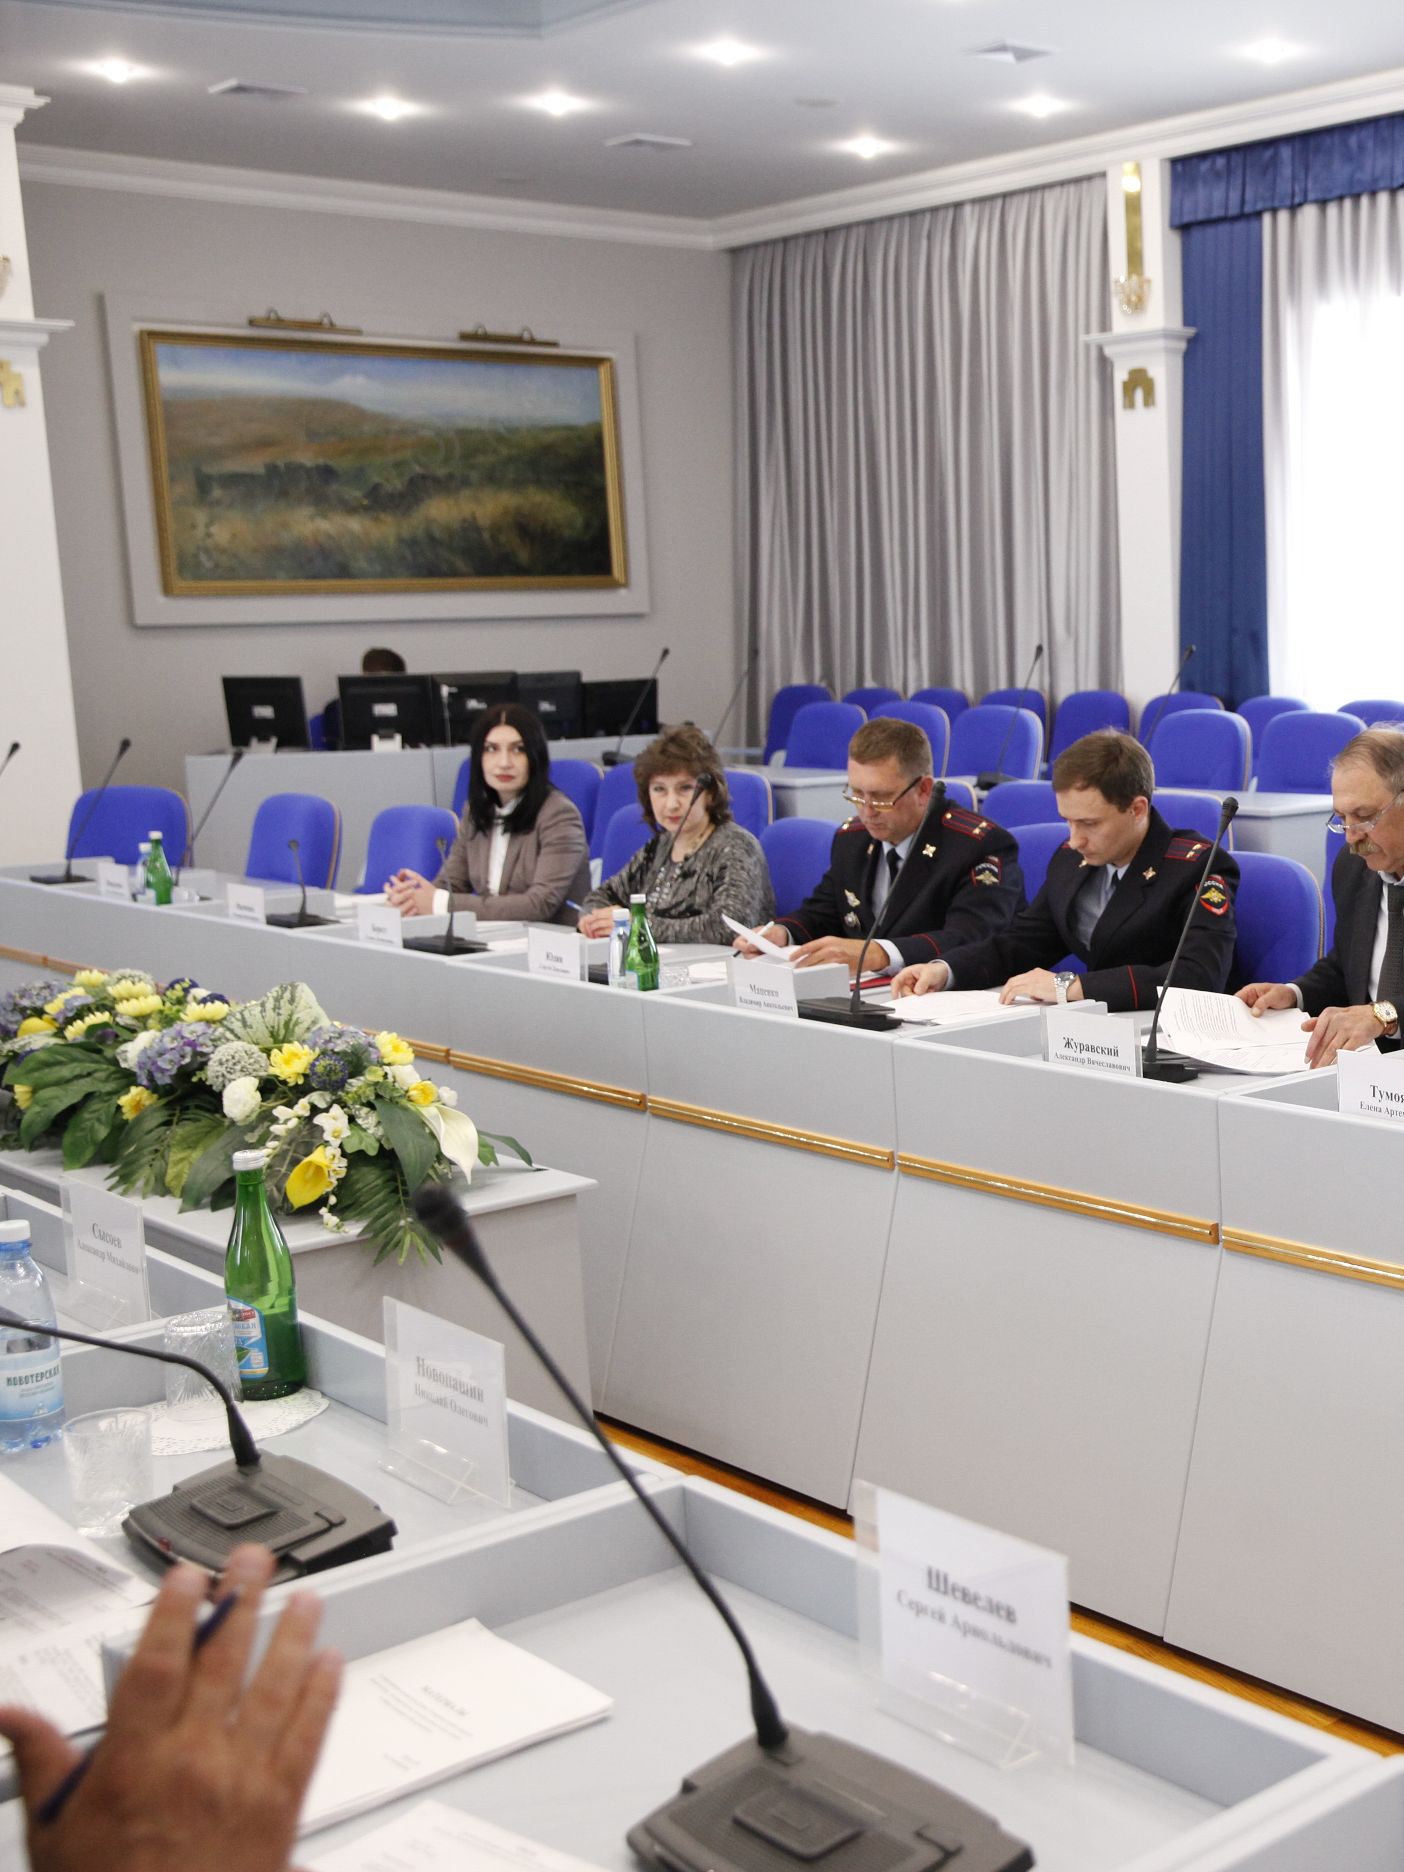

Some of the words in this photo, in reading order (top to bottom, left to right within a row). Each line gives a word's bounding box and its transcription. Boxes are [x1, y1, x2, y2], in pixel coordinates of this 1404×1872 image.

[1062, 1036, 1120, 1058] Журавский
[1055, 1052, 1086, 1066] Александр
[1087, 1056, 1131, 1072] Вячеславович
[1360, 1101, 1382, 1114] Елена
[91, 1222, 123, 1249] Сысоев
[925, 1564, 1018, 1626] Шевелев
[896, 1589, 947, 1626] Сергей
